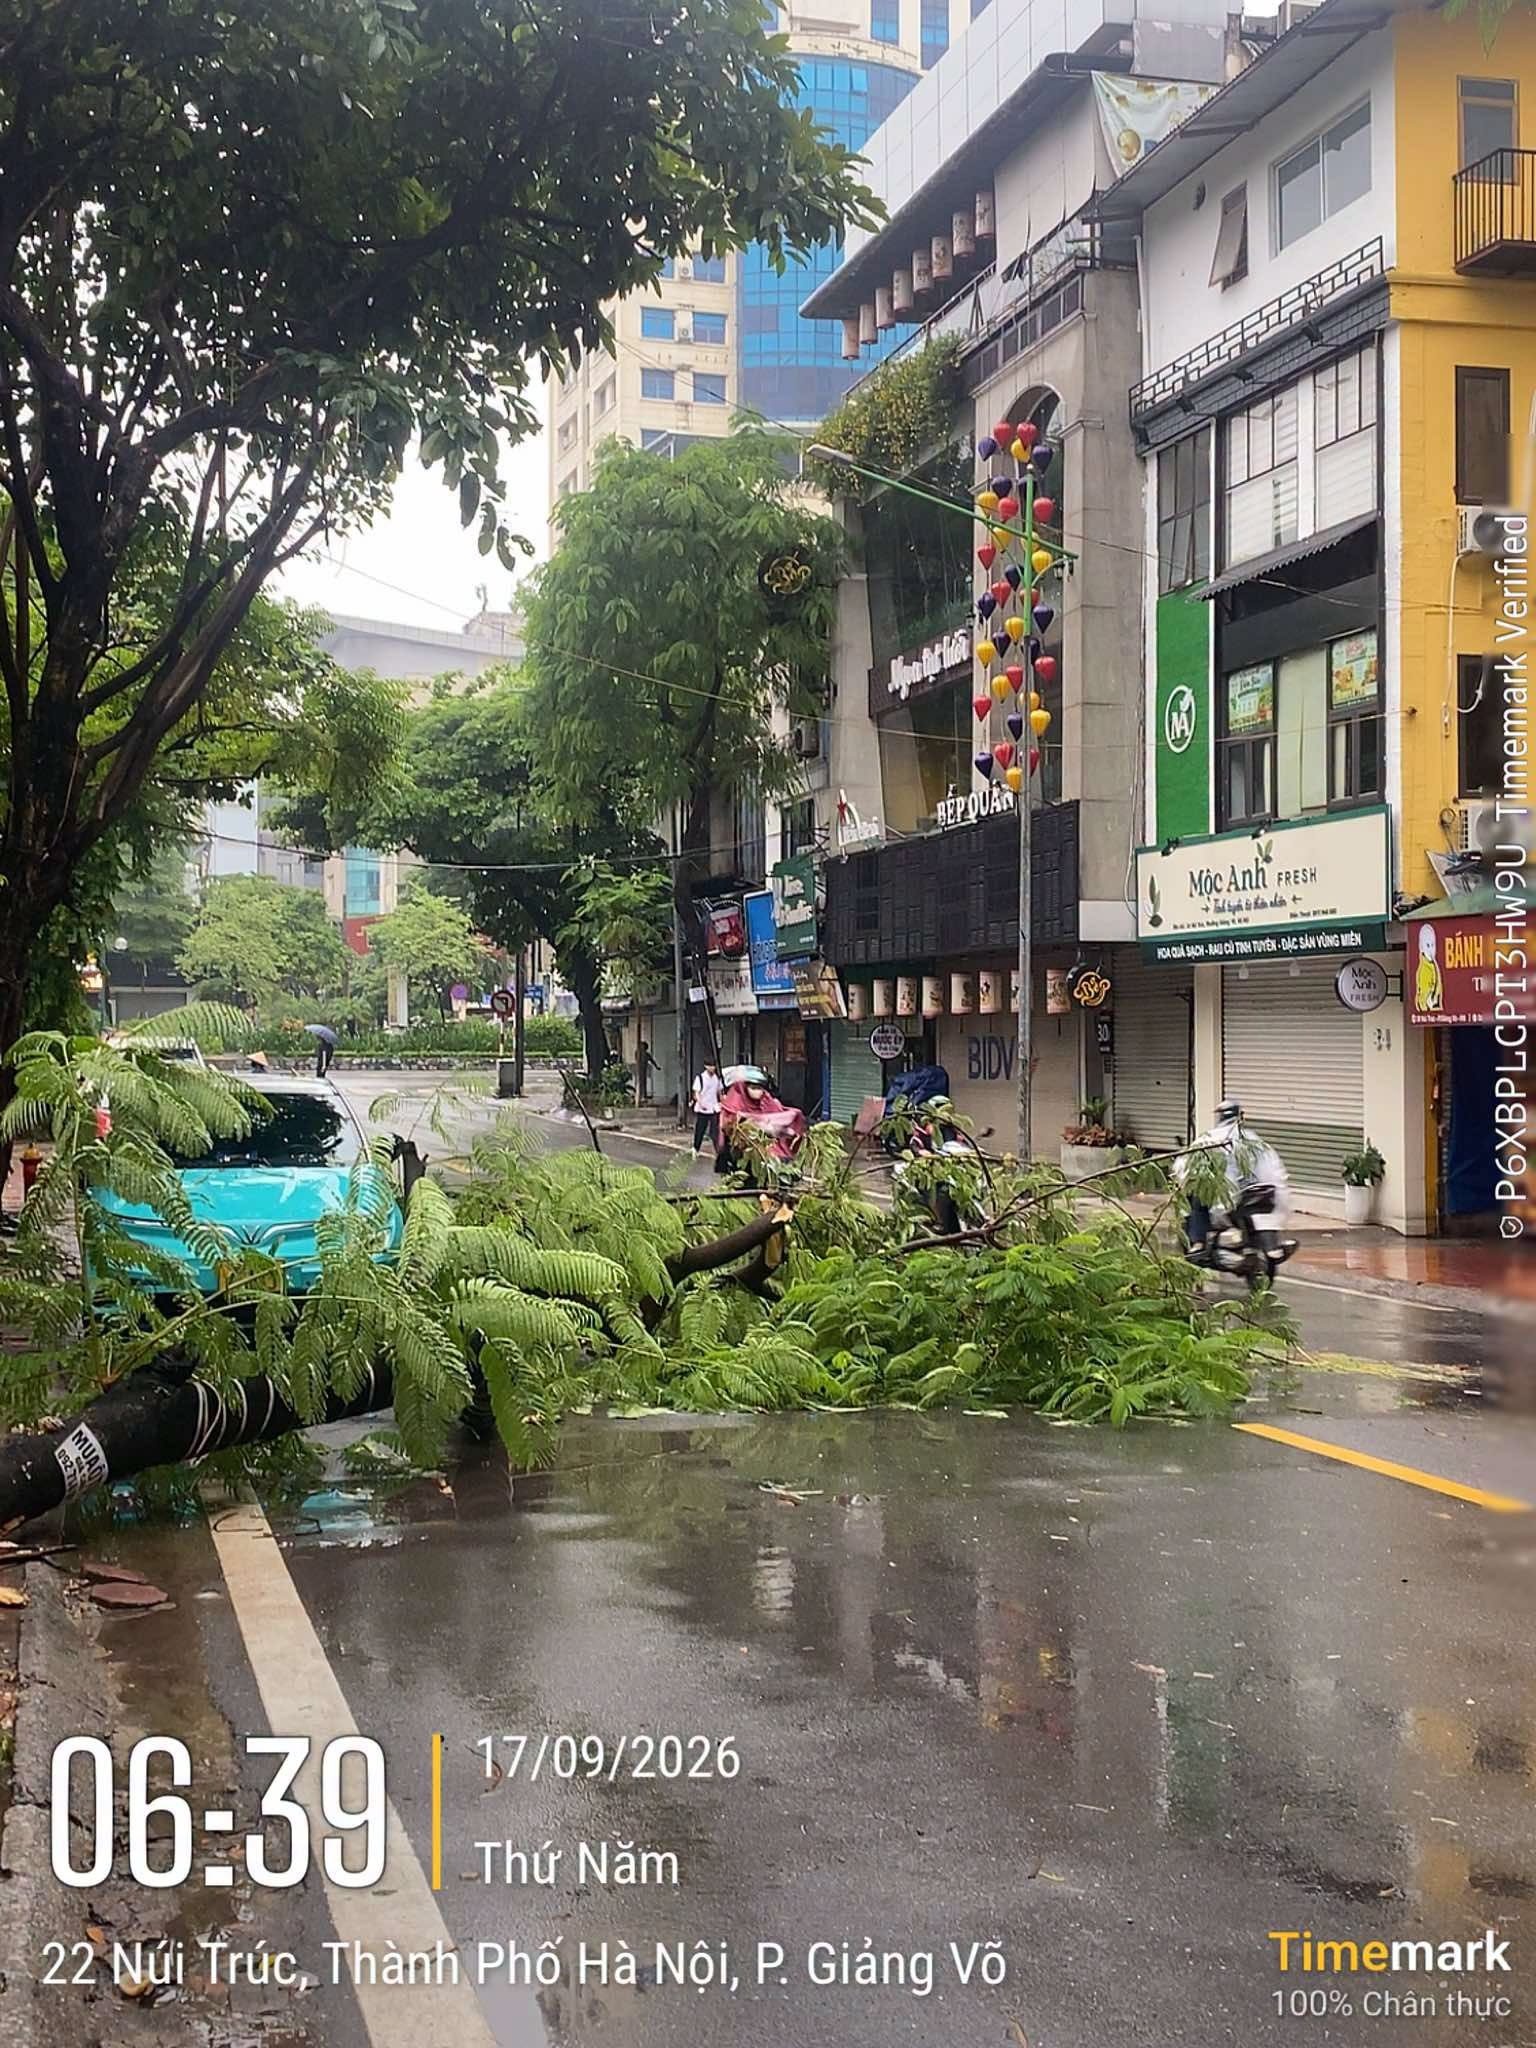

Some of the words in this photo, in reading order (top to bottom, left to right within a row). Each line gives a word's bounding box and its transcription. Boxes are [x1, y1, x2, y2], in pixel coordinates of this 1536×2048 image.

[936, 783, 965, 826] BẾP
[1188, 868, 1223, 902] Mộc
[1226, 856, 1268, 893] Anh
[1276, 866, 1317, 887] FRESH
[1316, 931, 1340, 949] VÙNG
[1445, 931, 1483, 969] BÁNH
[967, 1035, 1016, 1081] BIDV
[72, 1430, 100, 1472] MUA
